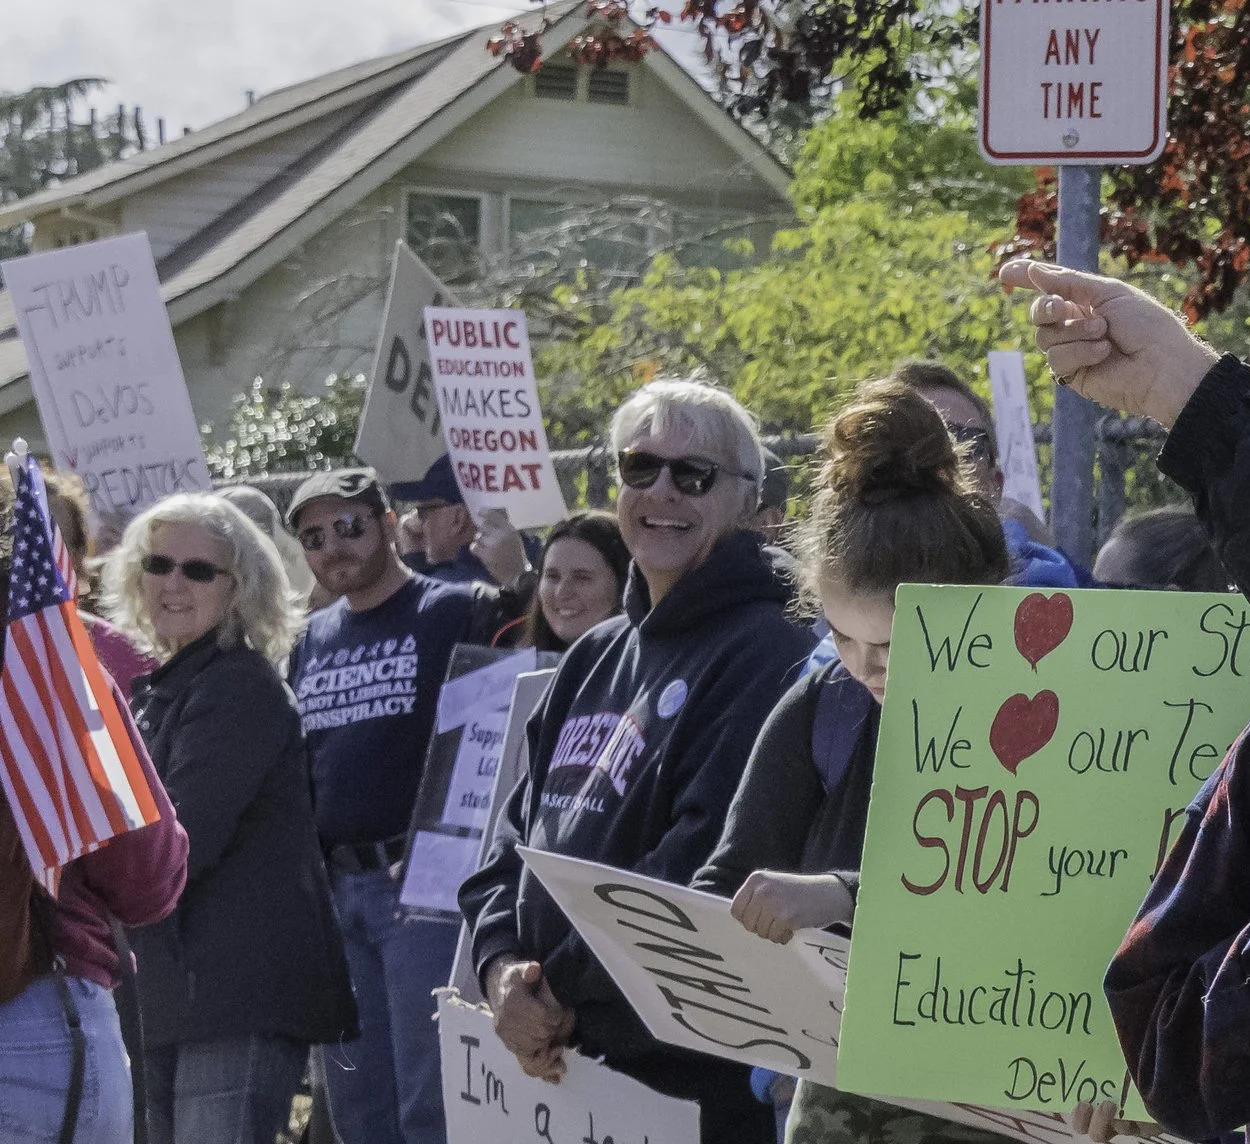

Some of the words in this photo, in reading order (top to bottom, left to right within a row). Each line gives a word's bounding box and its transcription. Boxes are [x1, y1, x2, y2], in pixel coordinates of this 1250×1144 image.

[1044, 29, 1100, 65] ANY
[1040, 82, 1103, 119] TIME
[32, 264, 130, 330] TRUMP
[432, 319, 520, 349] PUBLIC
[437, 358, 525, 377] EDUCATION
[442, 386, 531, 418] MAKES
[450, 427, 538, 452] OREGON
[457, 461, 542, 493] GREAT
[916, 593, 993, 673] We
[1091, 627, 1168, 673] our
[297, 654, 418, 700] SCIENCE
[307, 694, 335, 711] NOT
[336, 691, 347, 705] A
[349, 680, 417, 703] LIBERAL
[912, 699, 971, 773] We
[1068, 726, 1149, 775] our
[1164, 698, 1232, 786] Te
[901, 786, 1039, 896] STOP
[1040, 846, 1127, 896] your
[594, 883, 811, 1070] STAND
[893, 951, 1092, 1036] Education
[459, 1034, 508, 1115] I'm
